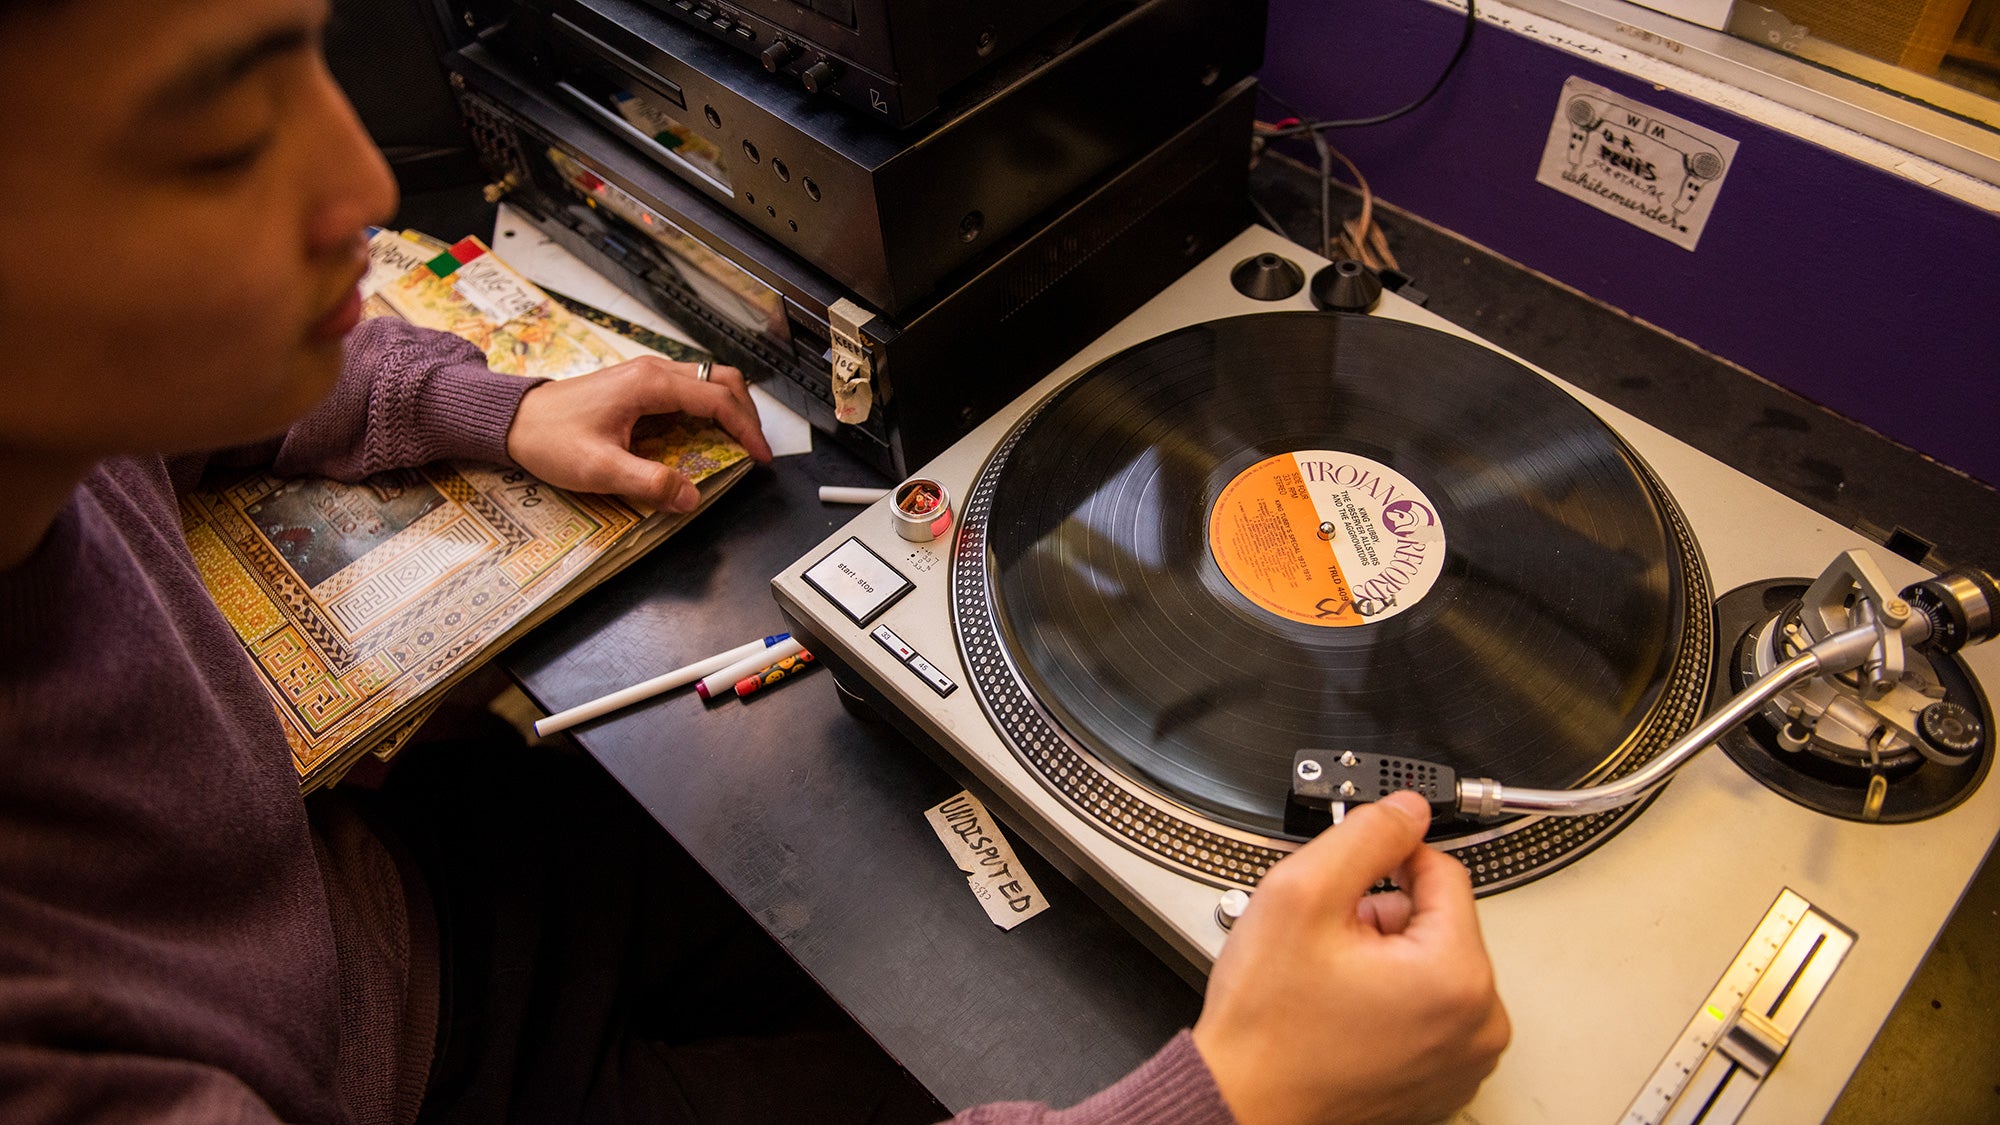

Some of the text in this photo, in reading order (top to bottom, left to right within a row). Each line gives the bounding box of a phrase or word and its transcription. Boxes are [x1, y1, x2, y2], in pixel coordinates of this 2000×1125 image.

[833, 333, 861, 356] KEEP
[1274, 475, 1287, 495] STEREO
[1298, 485, 1308, 500] FOUR
[1301, 461, 1404, 507] TROJAN
[1332, 494, 1370, 566] AND THE AGGROVATORS
[1341, 490, 1380, 566] THE OBSERVER ALLSTARS
[1358, 507, 1370, 523] KING
[837, 562, 874, 594] start stop
[1328, 565, 1349, 602] TRLD 409
[1352, 539, 1427, 602] RECORDS
[880, 631, 891, 640] 33
[919, 663, 928, 671] 45
[939, 796, 1032, 912] UNDISPUTED
